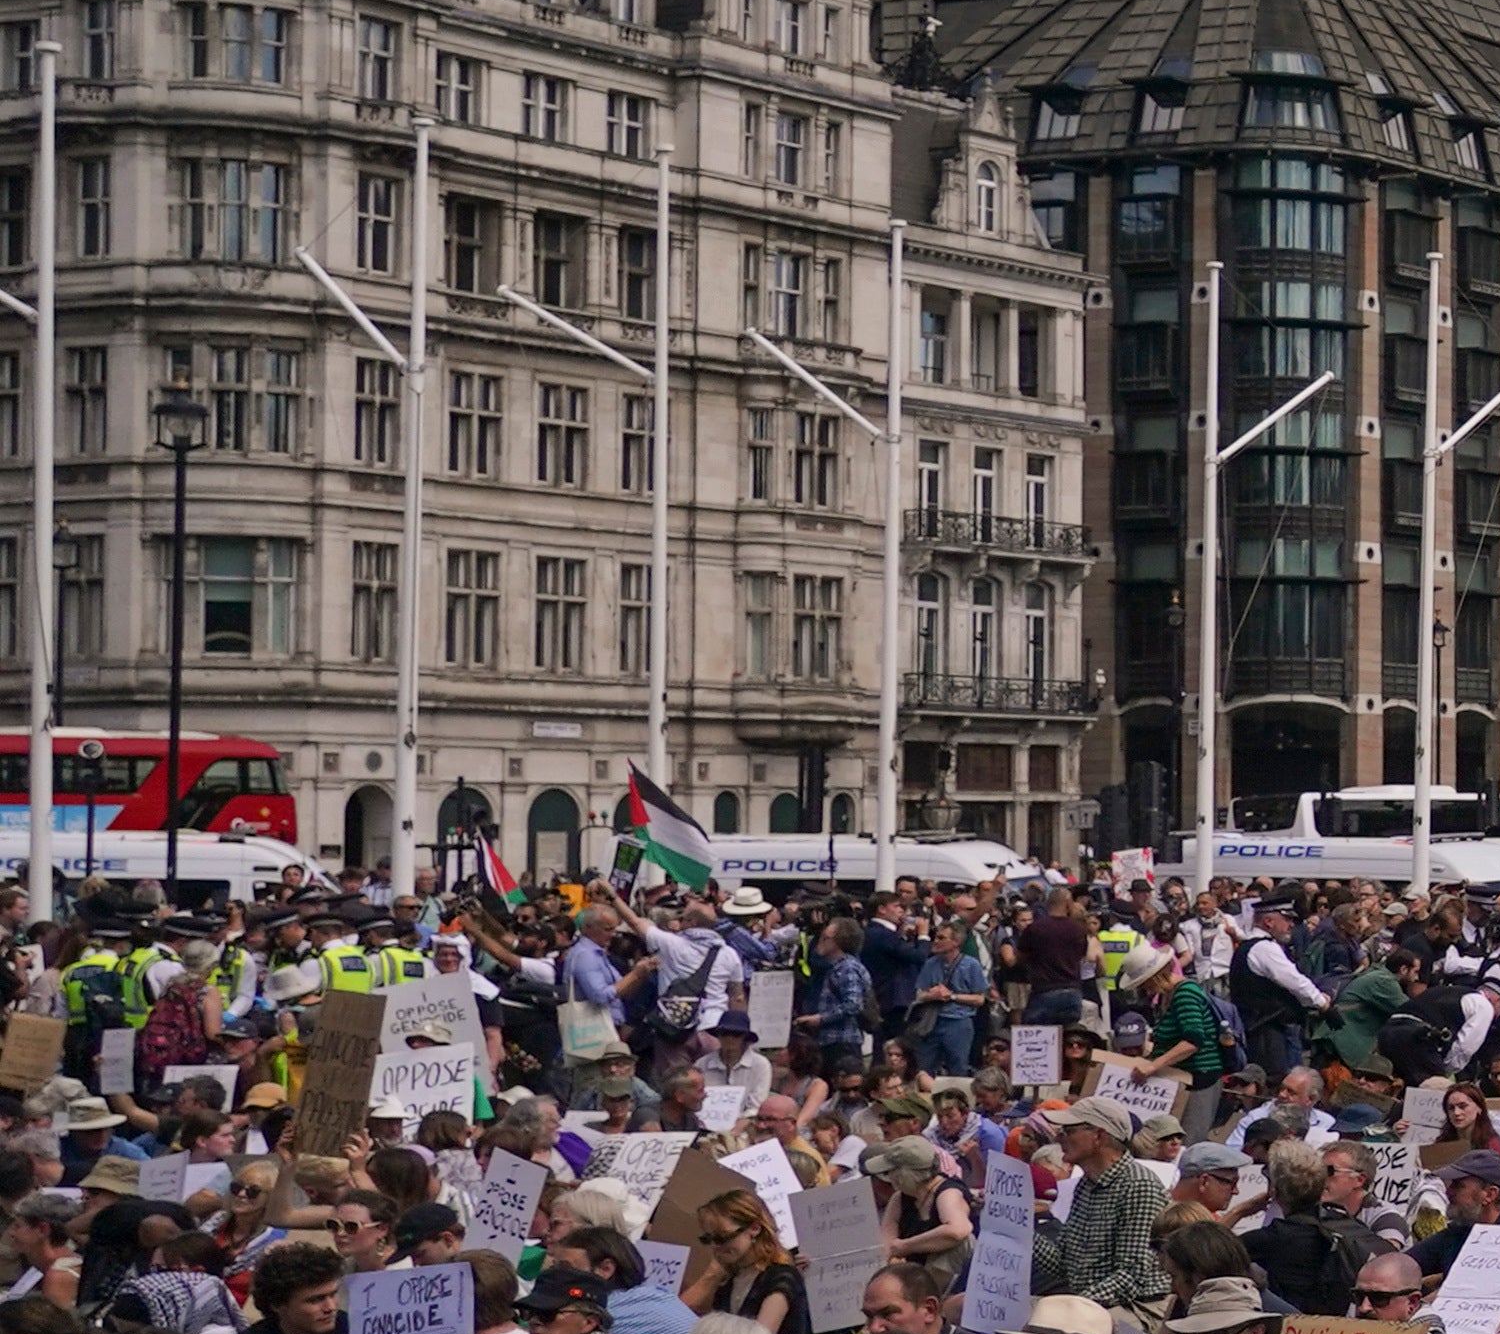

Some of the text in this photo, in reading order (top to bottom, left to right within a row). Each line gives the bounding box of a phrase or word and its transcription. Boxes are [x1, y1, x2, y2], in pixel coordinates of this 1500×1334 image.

[1219, 845, 1324, 859] POLICE
[723, 860, 839, 874] POLICE
[396, 996, 456, 1017] OPPOSE
[383, 1054, 469, 1091] OPPOSE
[988, 1200, 1029, 1227] GENOCIDE
[398, 1274, 452, 1306] OPPOSE
